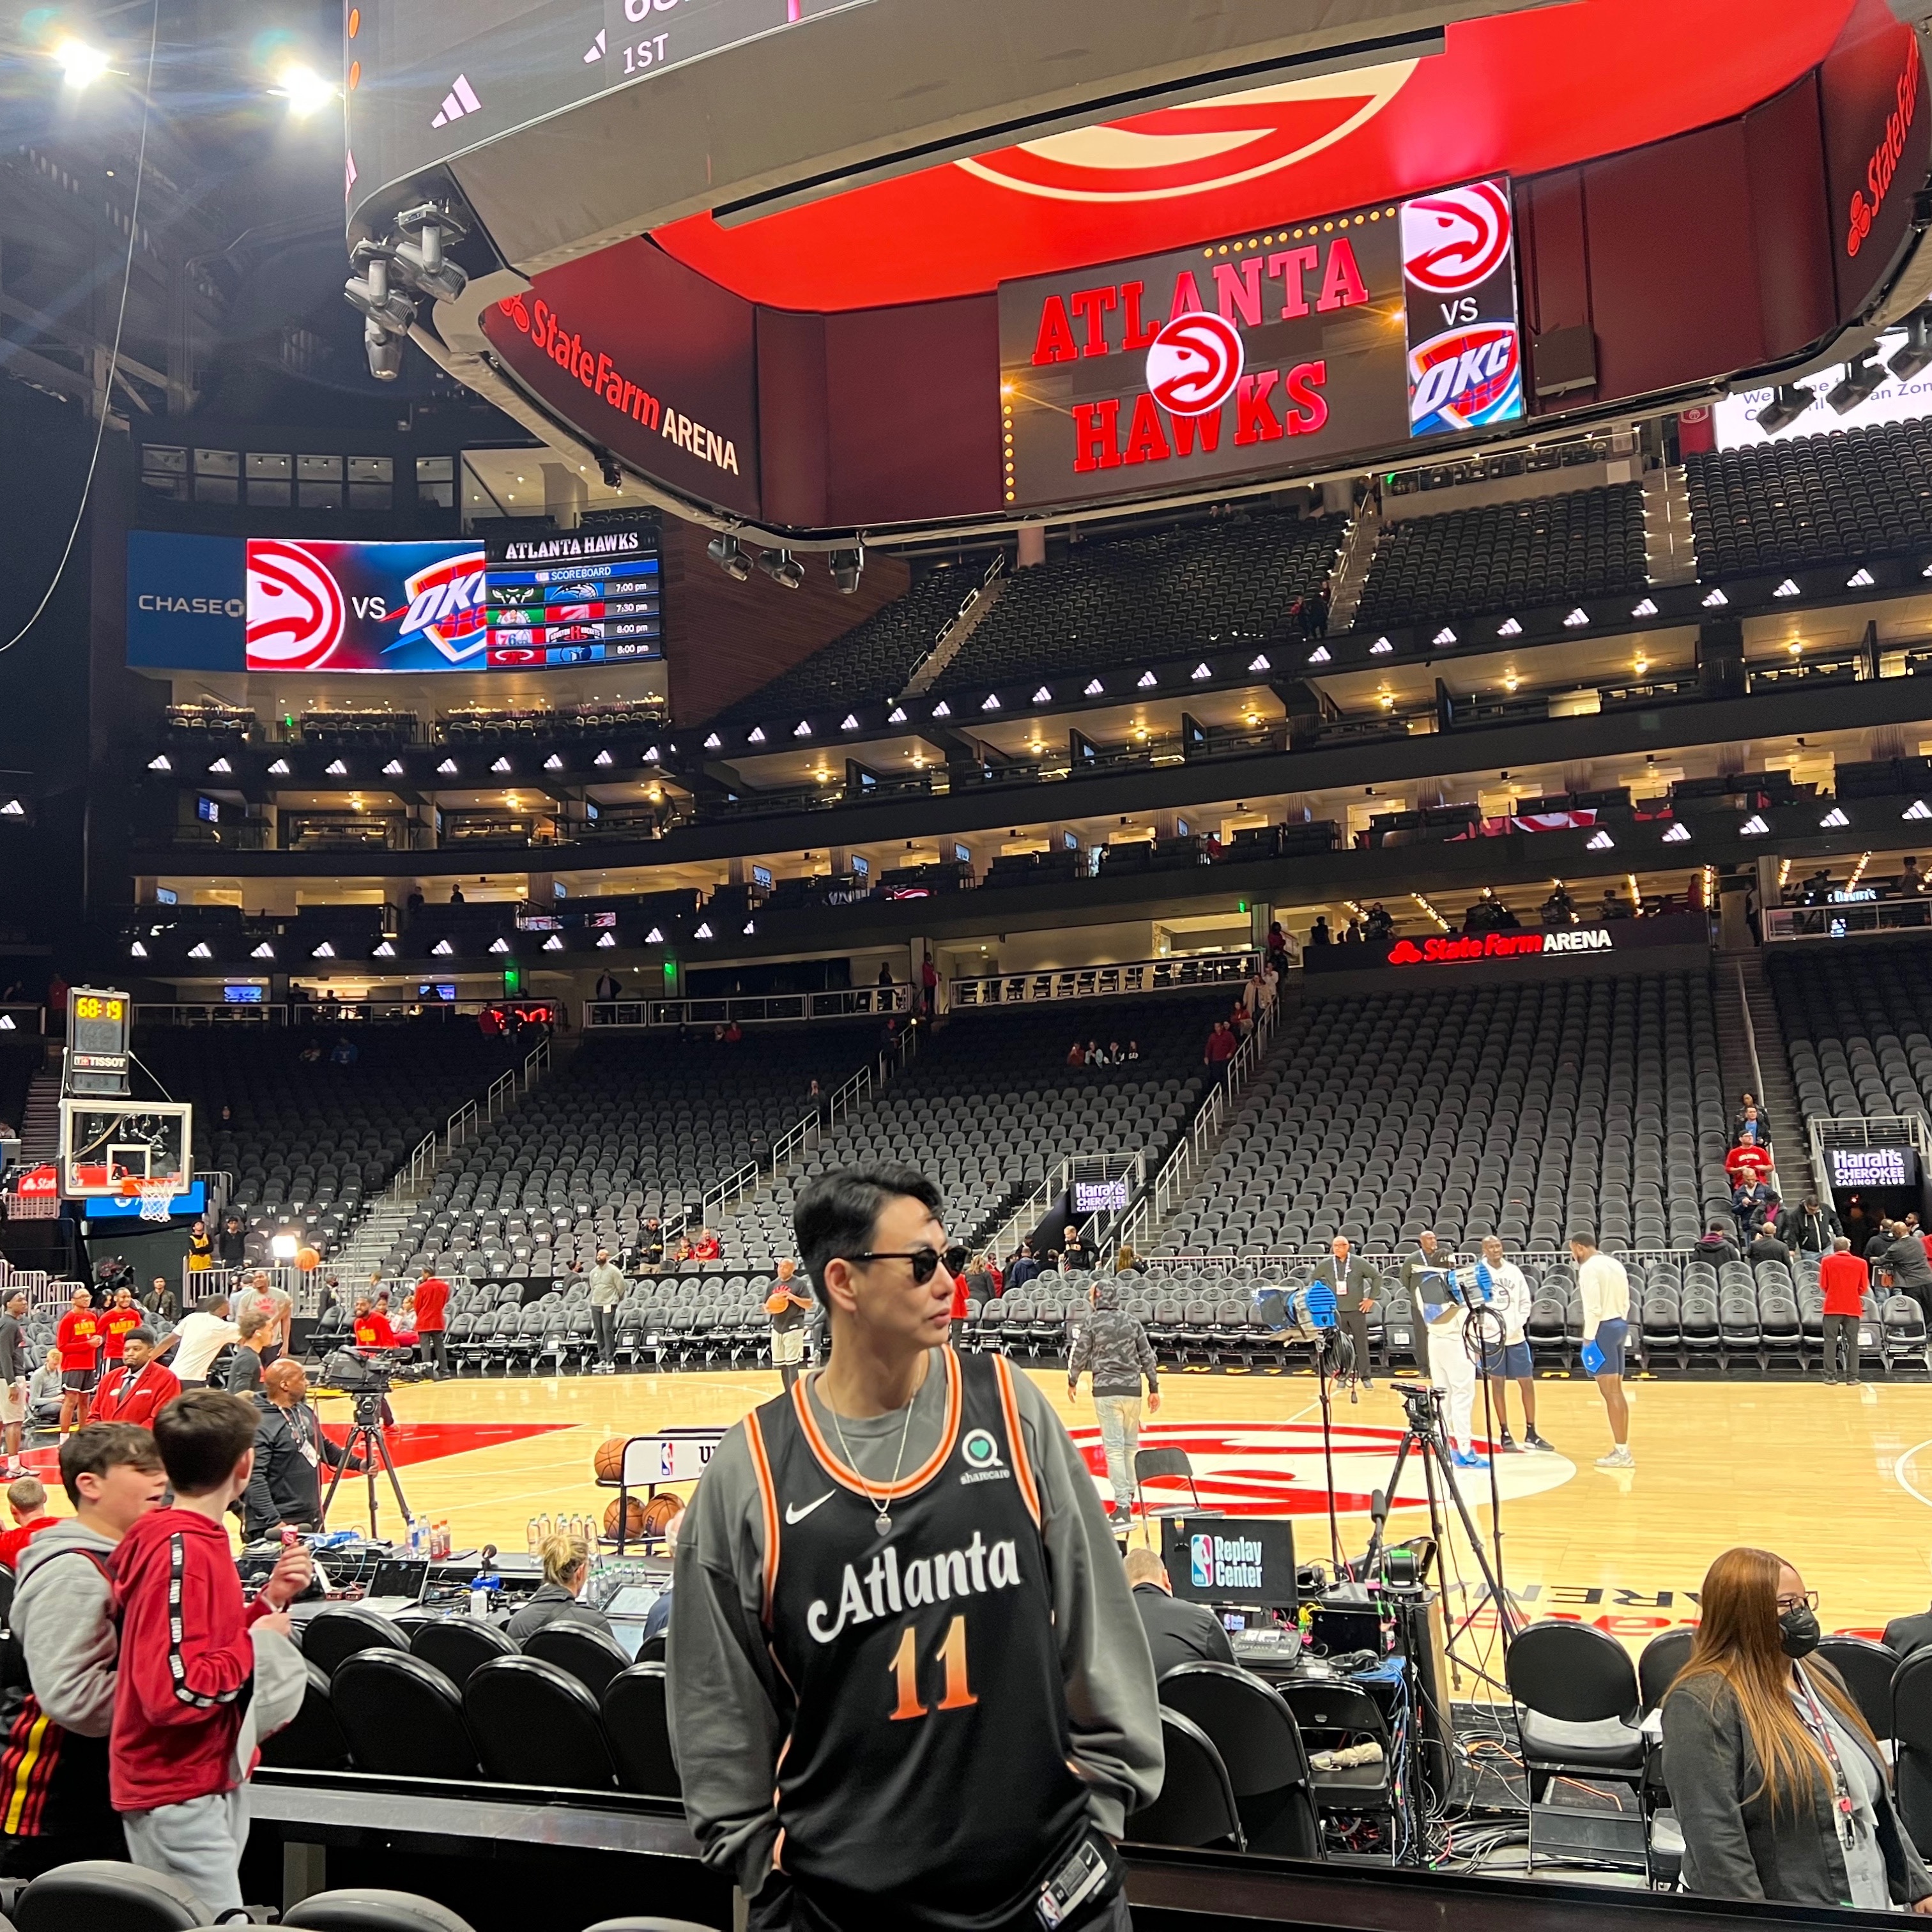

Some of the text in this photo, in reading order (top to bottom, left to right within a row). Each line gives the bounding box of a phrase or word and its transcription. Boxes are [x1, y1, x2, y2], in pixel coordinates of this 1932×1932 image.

[623, 33, 670, 75] 1ST
[1032, 238, 1369, 365] ATLANTA
[1441, 296, 1479, 326] VS
[1411, 335, 1514, 421] OKC
[1868, 388, 1892, 401] an
[1072, 360, 1330, 473] HAWKS
[661, 407, 740, 476] ARENA
[505, 532, 638, 560] ATLANTA HAWKS
[551, 567, 611, 581] SCOREBOARD
[616, 583, 647, 593] 7:00 pm
[139, 595, 223, 615] CHASE
[351, 596, 387, 620] VS
[616, 602, 648, 613] 7:30 pm
[617, 624, 648, 634] 8:00 pm
[617, 644, 649, 656] 8:00 pm
[1423, 929, 1613, 961] State Farm ARENA
[77, 997, 123, 1020] 68:19
[90, 1056, 126, 1068] TISSOT
[1832, 1148, 1904, 1169] Harrah's
[1835, 1167, 1905, 1180] CHEROKEE
[1836, 1177, 1905, 1186] CASINOS CLUB
[960, 1469, 1011, 1485] sharecare
[1213, 1535, 1263, 1566] Replay
[1215, 1560, 1264, 1589] Center
[806, 1531, 1021, 1644] Atlanta
[888, 1614, 979, 1721] 11
